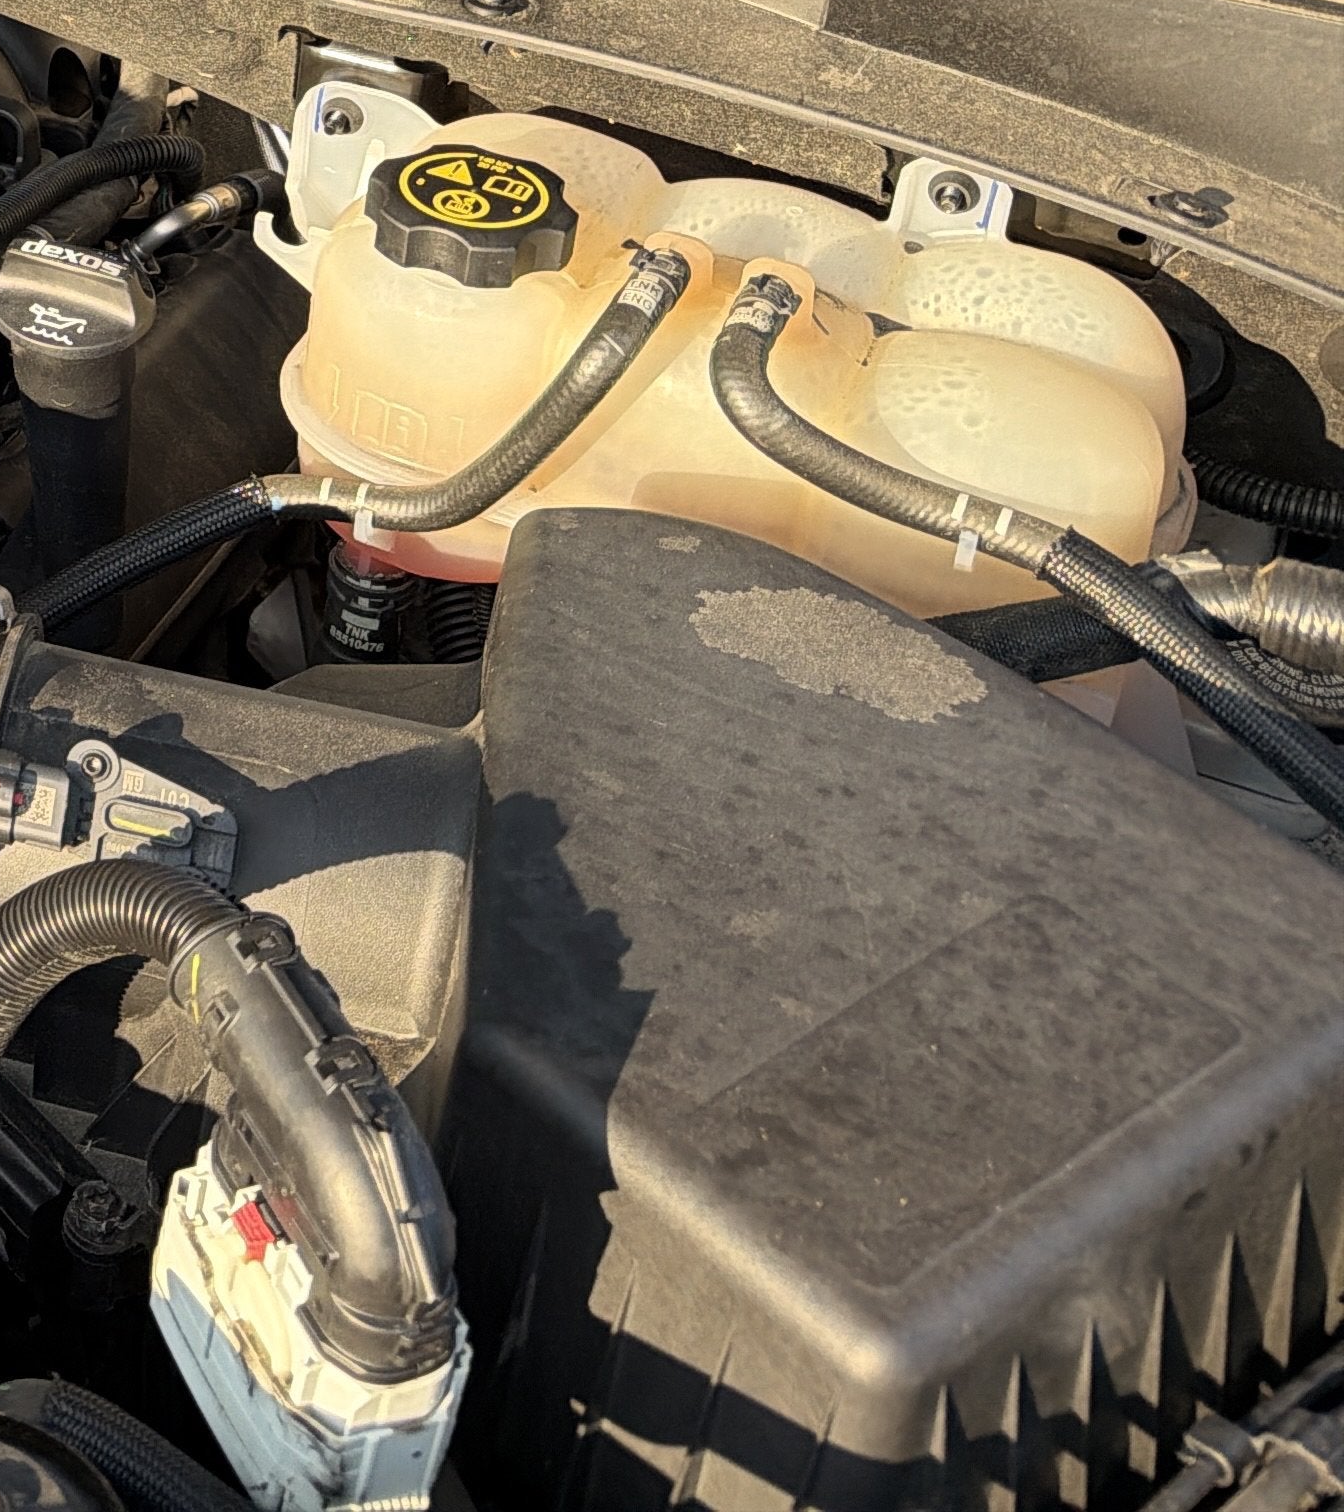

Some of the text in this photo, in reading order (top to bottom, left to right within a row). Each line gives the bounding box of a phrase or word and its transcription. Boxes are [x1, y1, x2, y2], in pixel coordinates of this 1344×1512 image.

[21, 239, 127, 276] dexos
[621, 291, 653, 311] ENG
[345, 622, 370, 642] TNK
[1244, 647, 1264, 662] CAP
[1258, 661, 1299, 690] BEFORE
[1282, 687, 1315, 706] FROM
